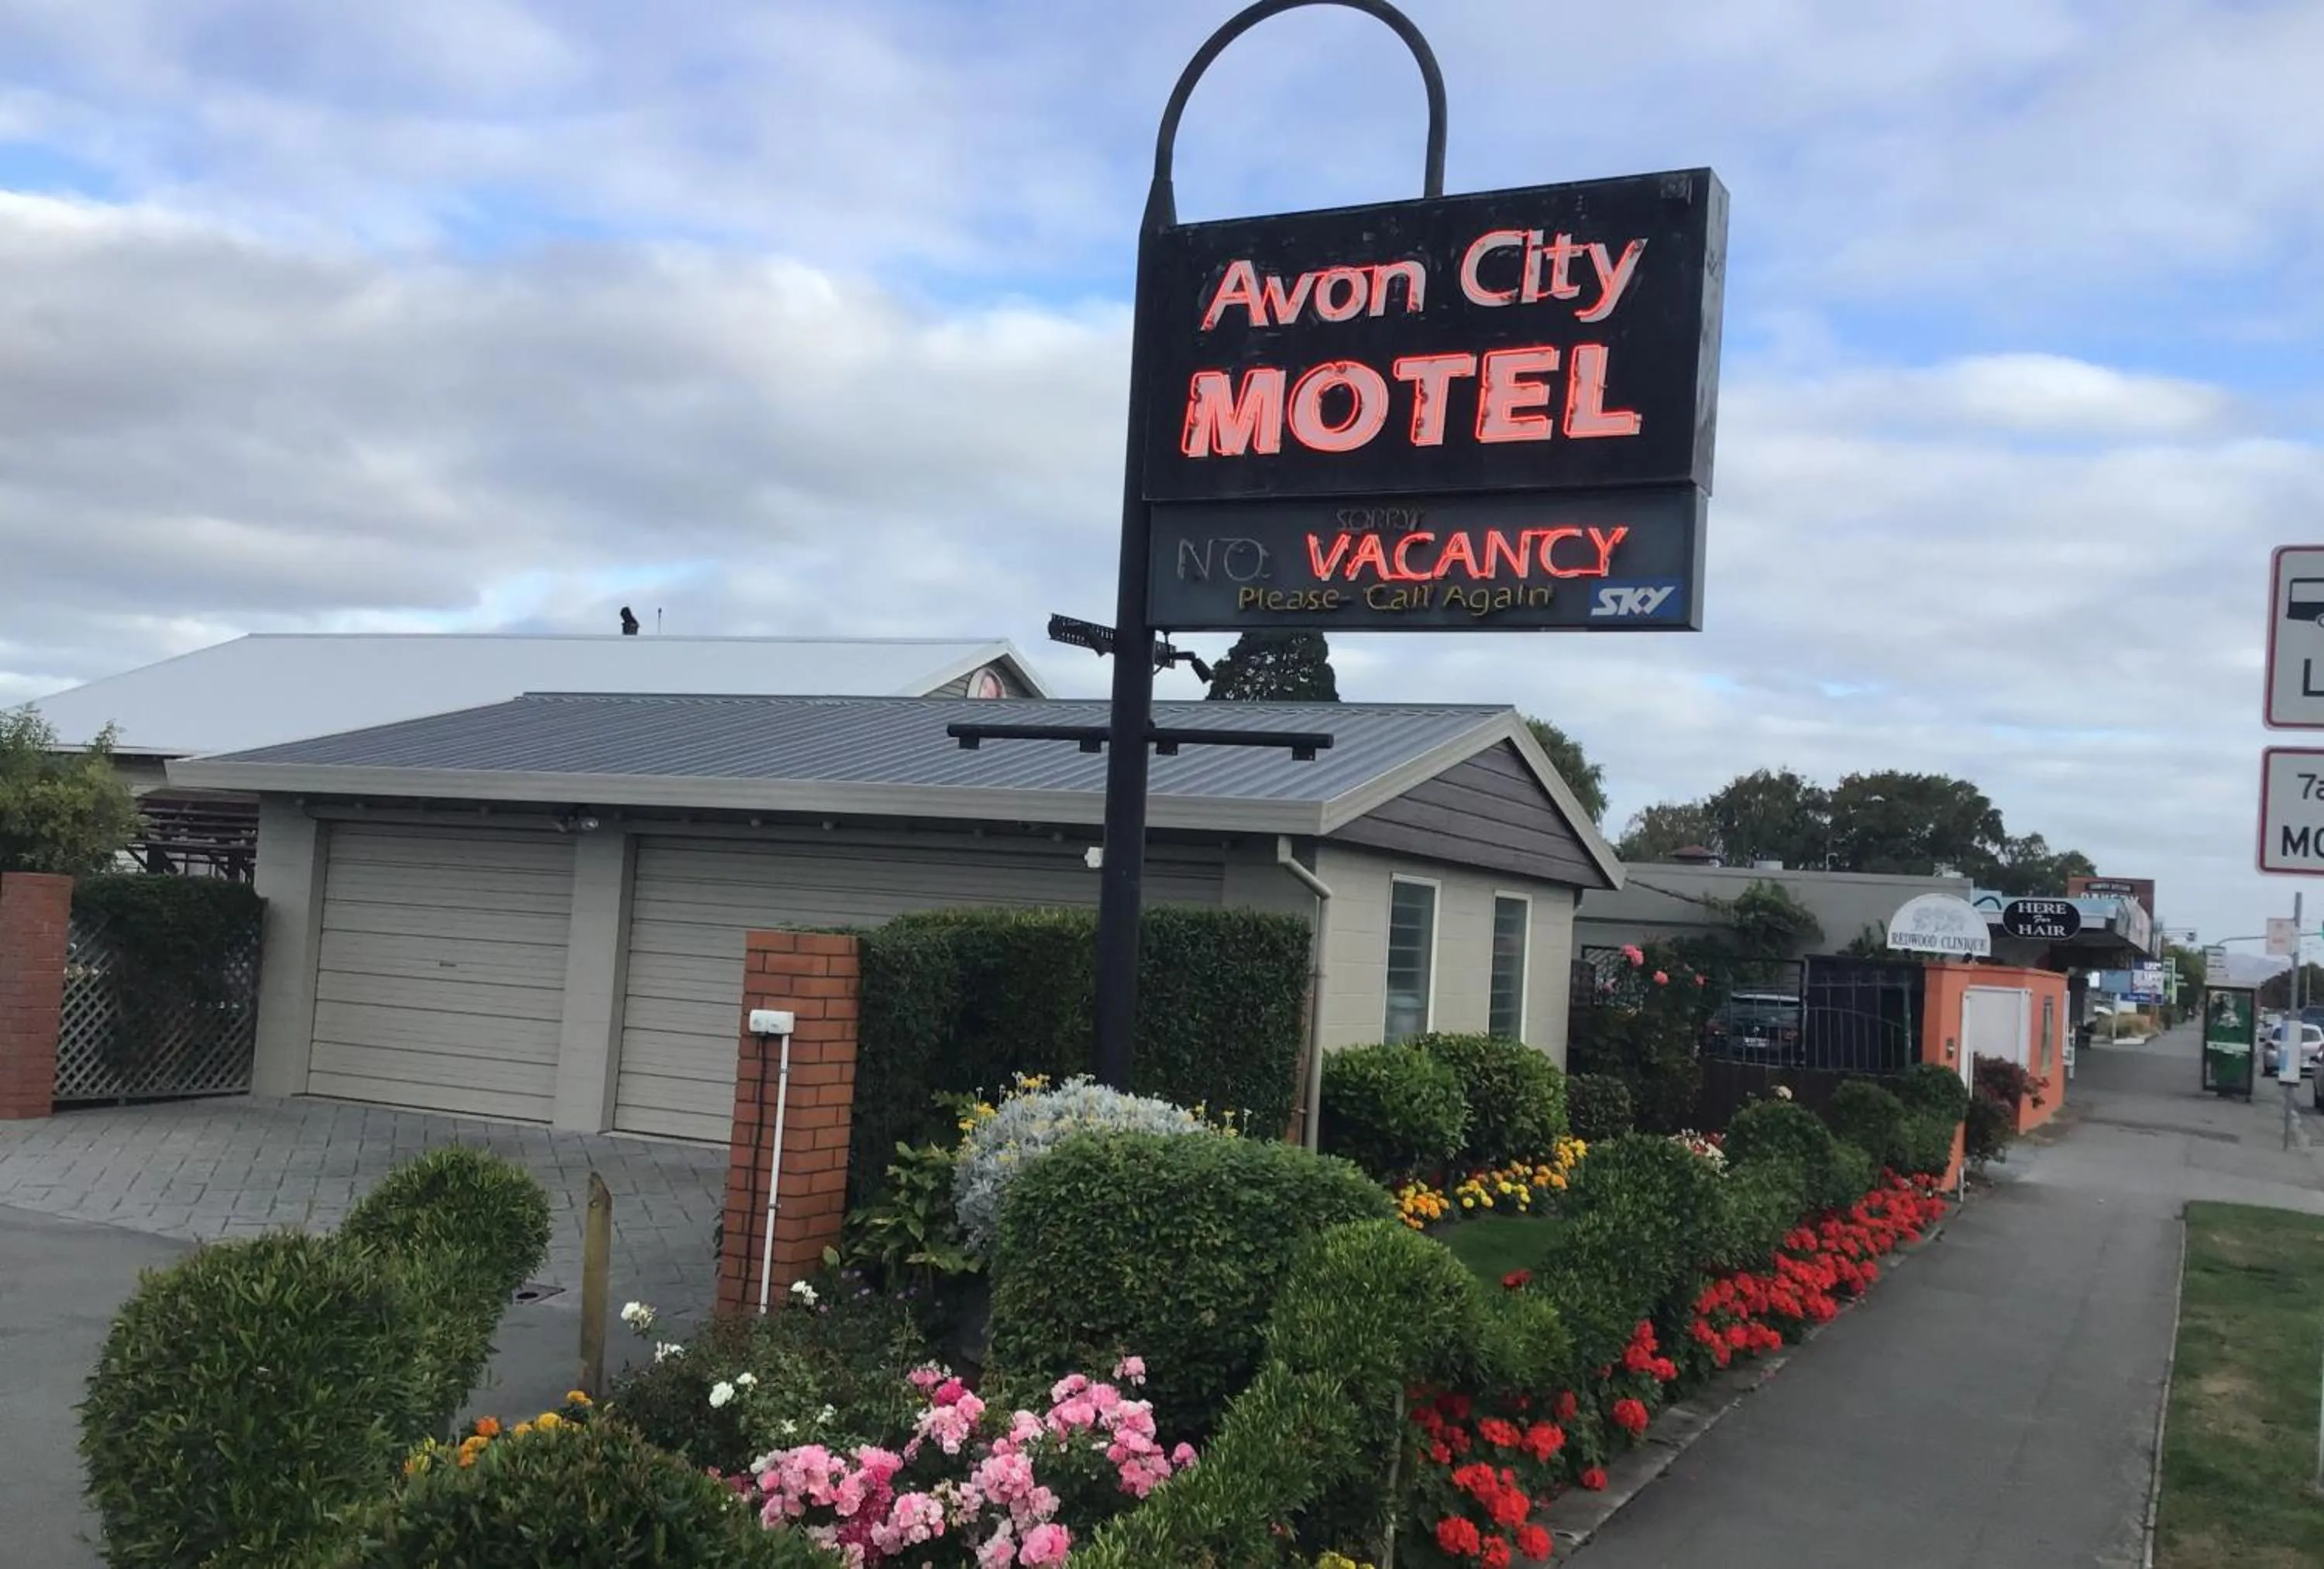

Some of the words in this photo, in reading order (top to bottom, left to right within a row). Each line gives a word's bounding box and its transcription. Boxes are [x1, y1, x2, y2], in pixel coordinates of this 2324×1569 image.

[1200, 259, 1426, 331] Avon
[1459, 228, 1648, 323] City
[1181, 344, 1642, 458] MOTEL
[1177, 537, 1269, 582] NO
[1305, 526, 1628, 582] VACANCY
[1364, 583, 1432, 611] Call
[1442, 582, 1552, 617] Again
[1590, 585, 1676, 617] SKY
[2018, 901, 2068, 915] HERE
[1891, 932, 1937, 948] REDWOOD
[1941, 936, 1988, 953] CLINIQUE
[2018, 924, 2066, 936] HAIR
